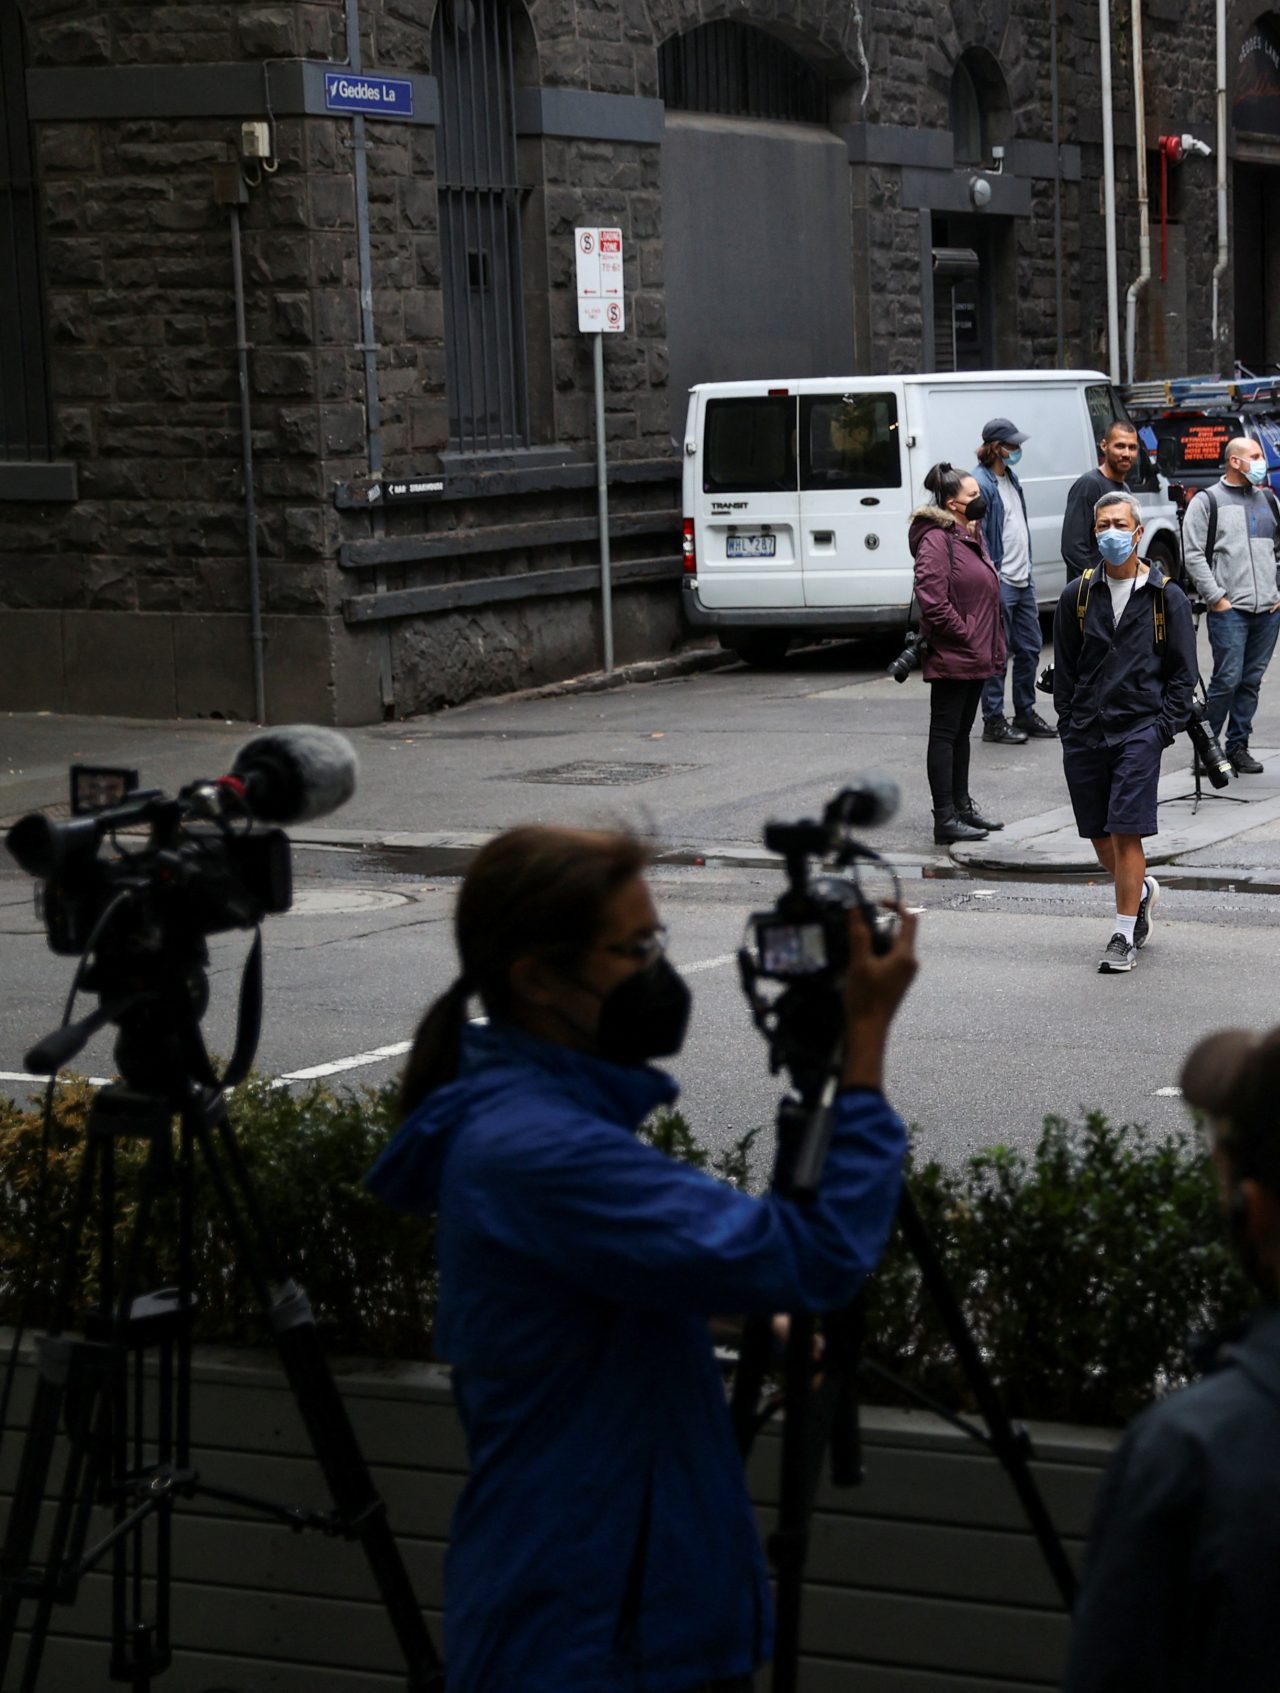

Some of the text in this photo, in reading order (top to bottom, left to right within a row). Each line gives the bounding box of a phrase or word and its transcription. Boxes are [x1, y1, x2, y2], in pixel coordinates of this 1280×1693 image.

[339, 80, 396, 102] Geddes La
[711, 502, 749, 510] TRANSIT
[755, 537, 774, 551] 287
